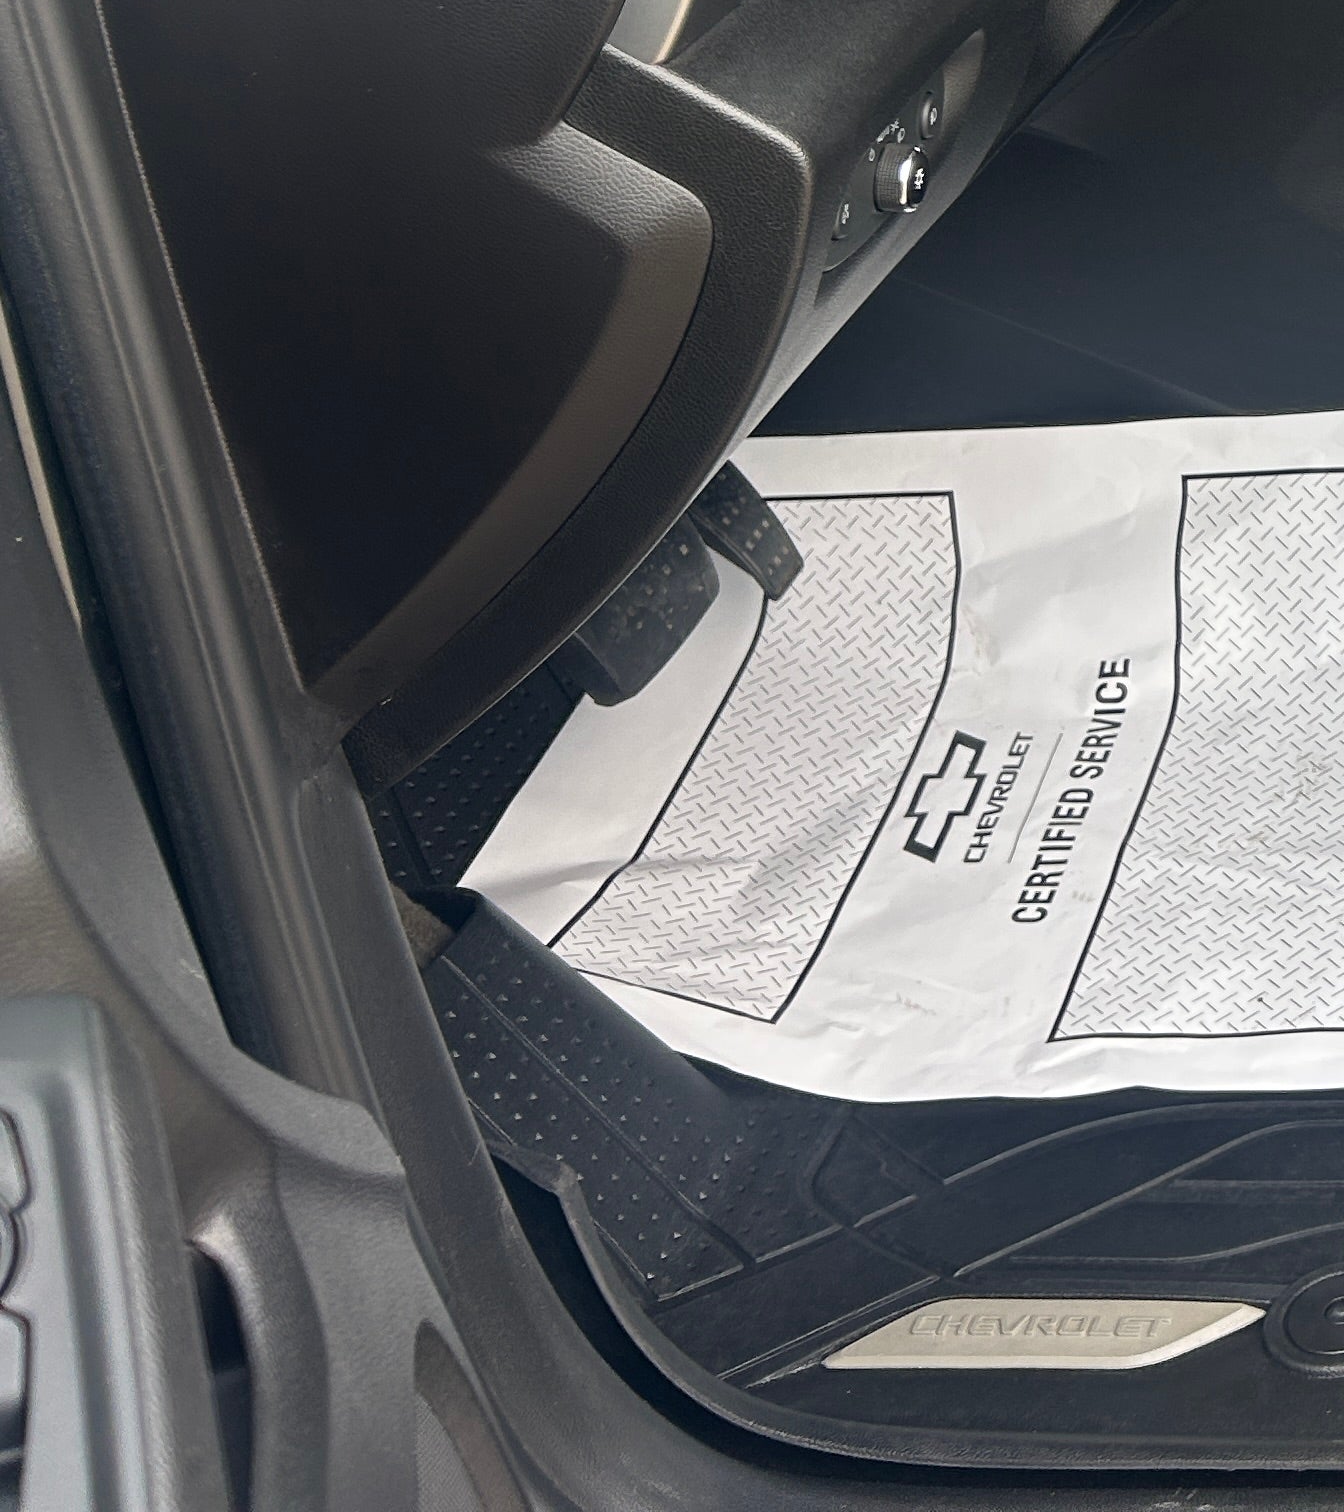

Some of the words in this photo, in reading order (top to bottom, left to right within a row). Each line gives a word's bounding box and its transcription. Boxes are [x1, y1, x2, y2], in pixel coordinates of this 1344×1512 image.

[963, 731, 1034, 864] CHEVROLET
[1011, 788, 1095, 923] CERTIFIED
[1069, 658, 1131, 779] SERVICE
[909, 1314, 1171, 1337] CHEVROLET
